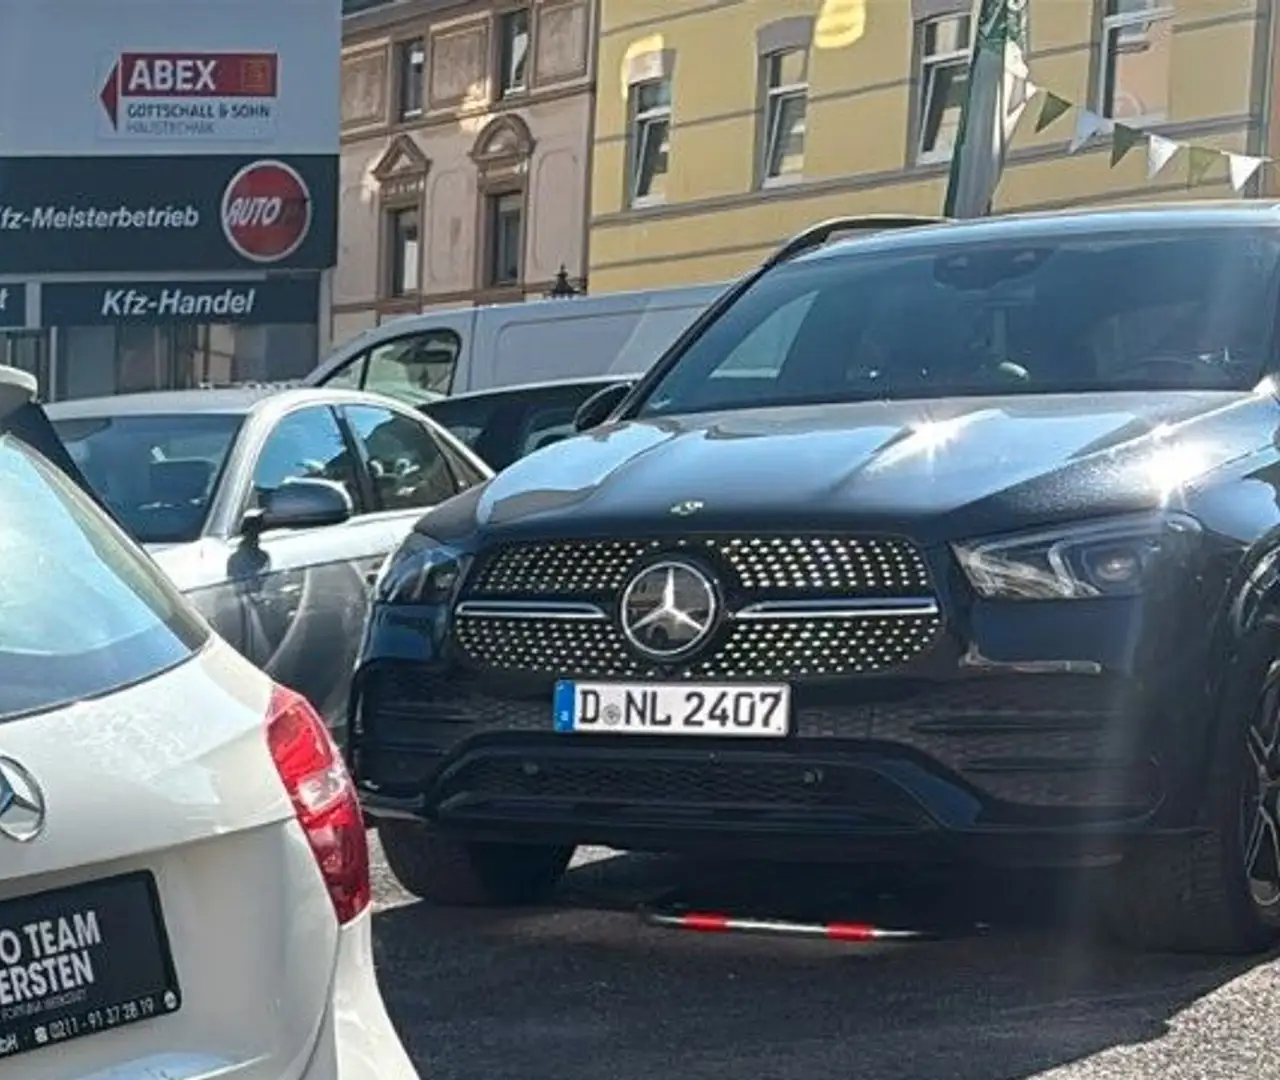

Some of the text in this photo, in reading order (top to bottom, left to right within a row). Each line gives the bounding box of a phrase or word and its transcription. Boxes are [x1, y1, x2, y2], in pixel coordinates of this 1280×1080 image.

[128, 59, 217, 91] ABEX
[128, 103, 214, 119] GOTTSCHALL
[231, 104, 270, 119] SOHN
[228, 196, 282, 227] AUTO
[101, 287, 256, 316] Kfz-Handel
[580, 690, 783, 727] D NL 2407
[22, 910, 101, 957] TEAM
